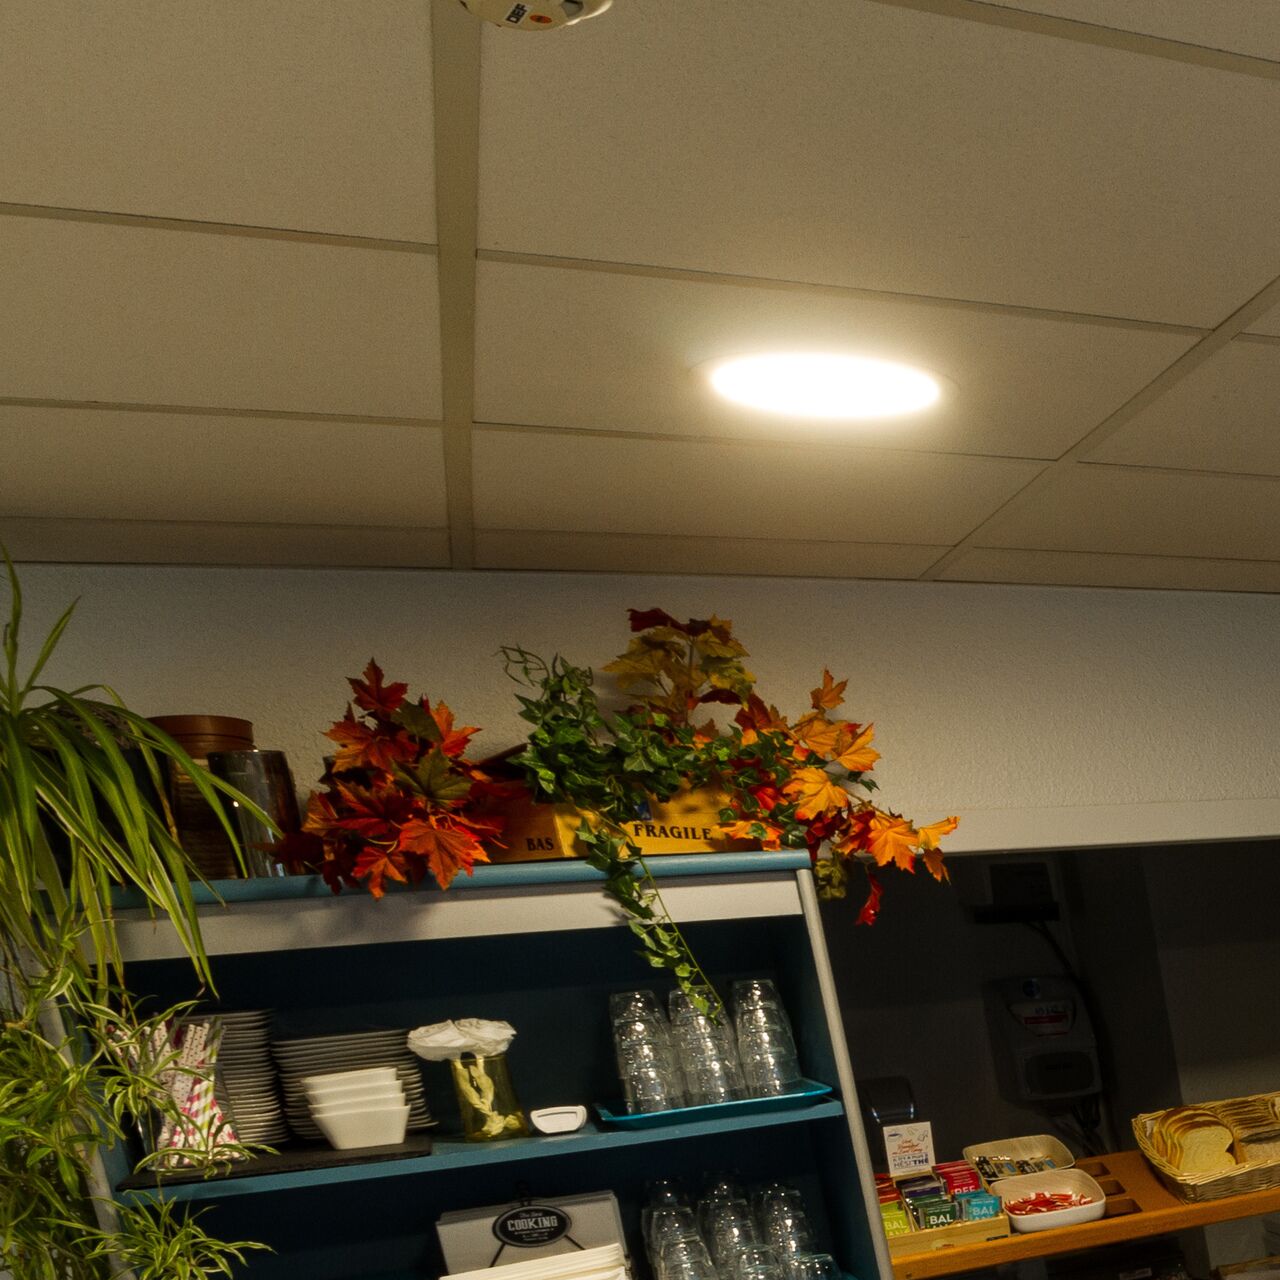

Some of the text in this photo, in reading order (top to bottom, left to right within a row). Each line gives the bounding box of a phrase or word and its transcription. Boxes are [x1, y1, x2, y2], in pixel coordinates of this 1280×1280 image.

[505, 3, 527, 24] DEF
[633, 823, 713, 841] FRAGILE
[526, 837, 555, 852] BAS
[972, 1207, 995, 1216] BAL
[507, 1216, 558, 1232] COOKING
[884, 1219, 907, 1229] BAL
[929, 1214, 954, 1225] BAL
